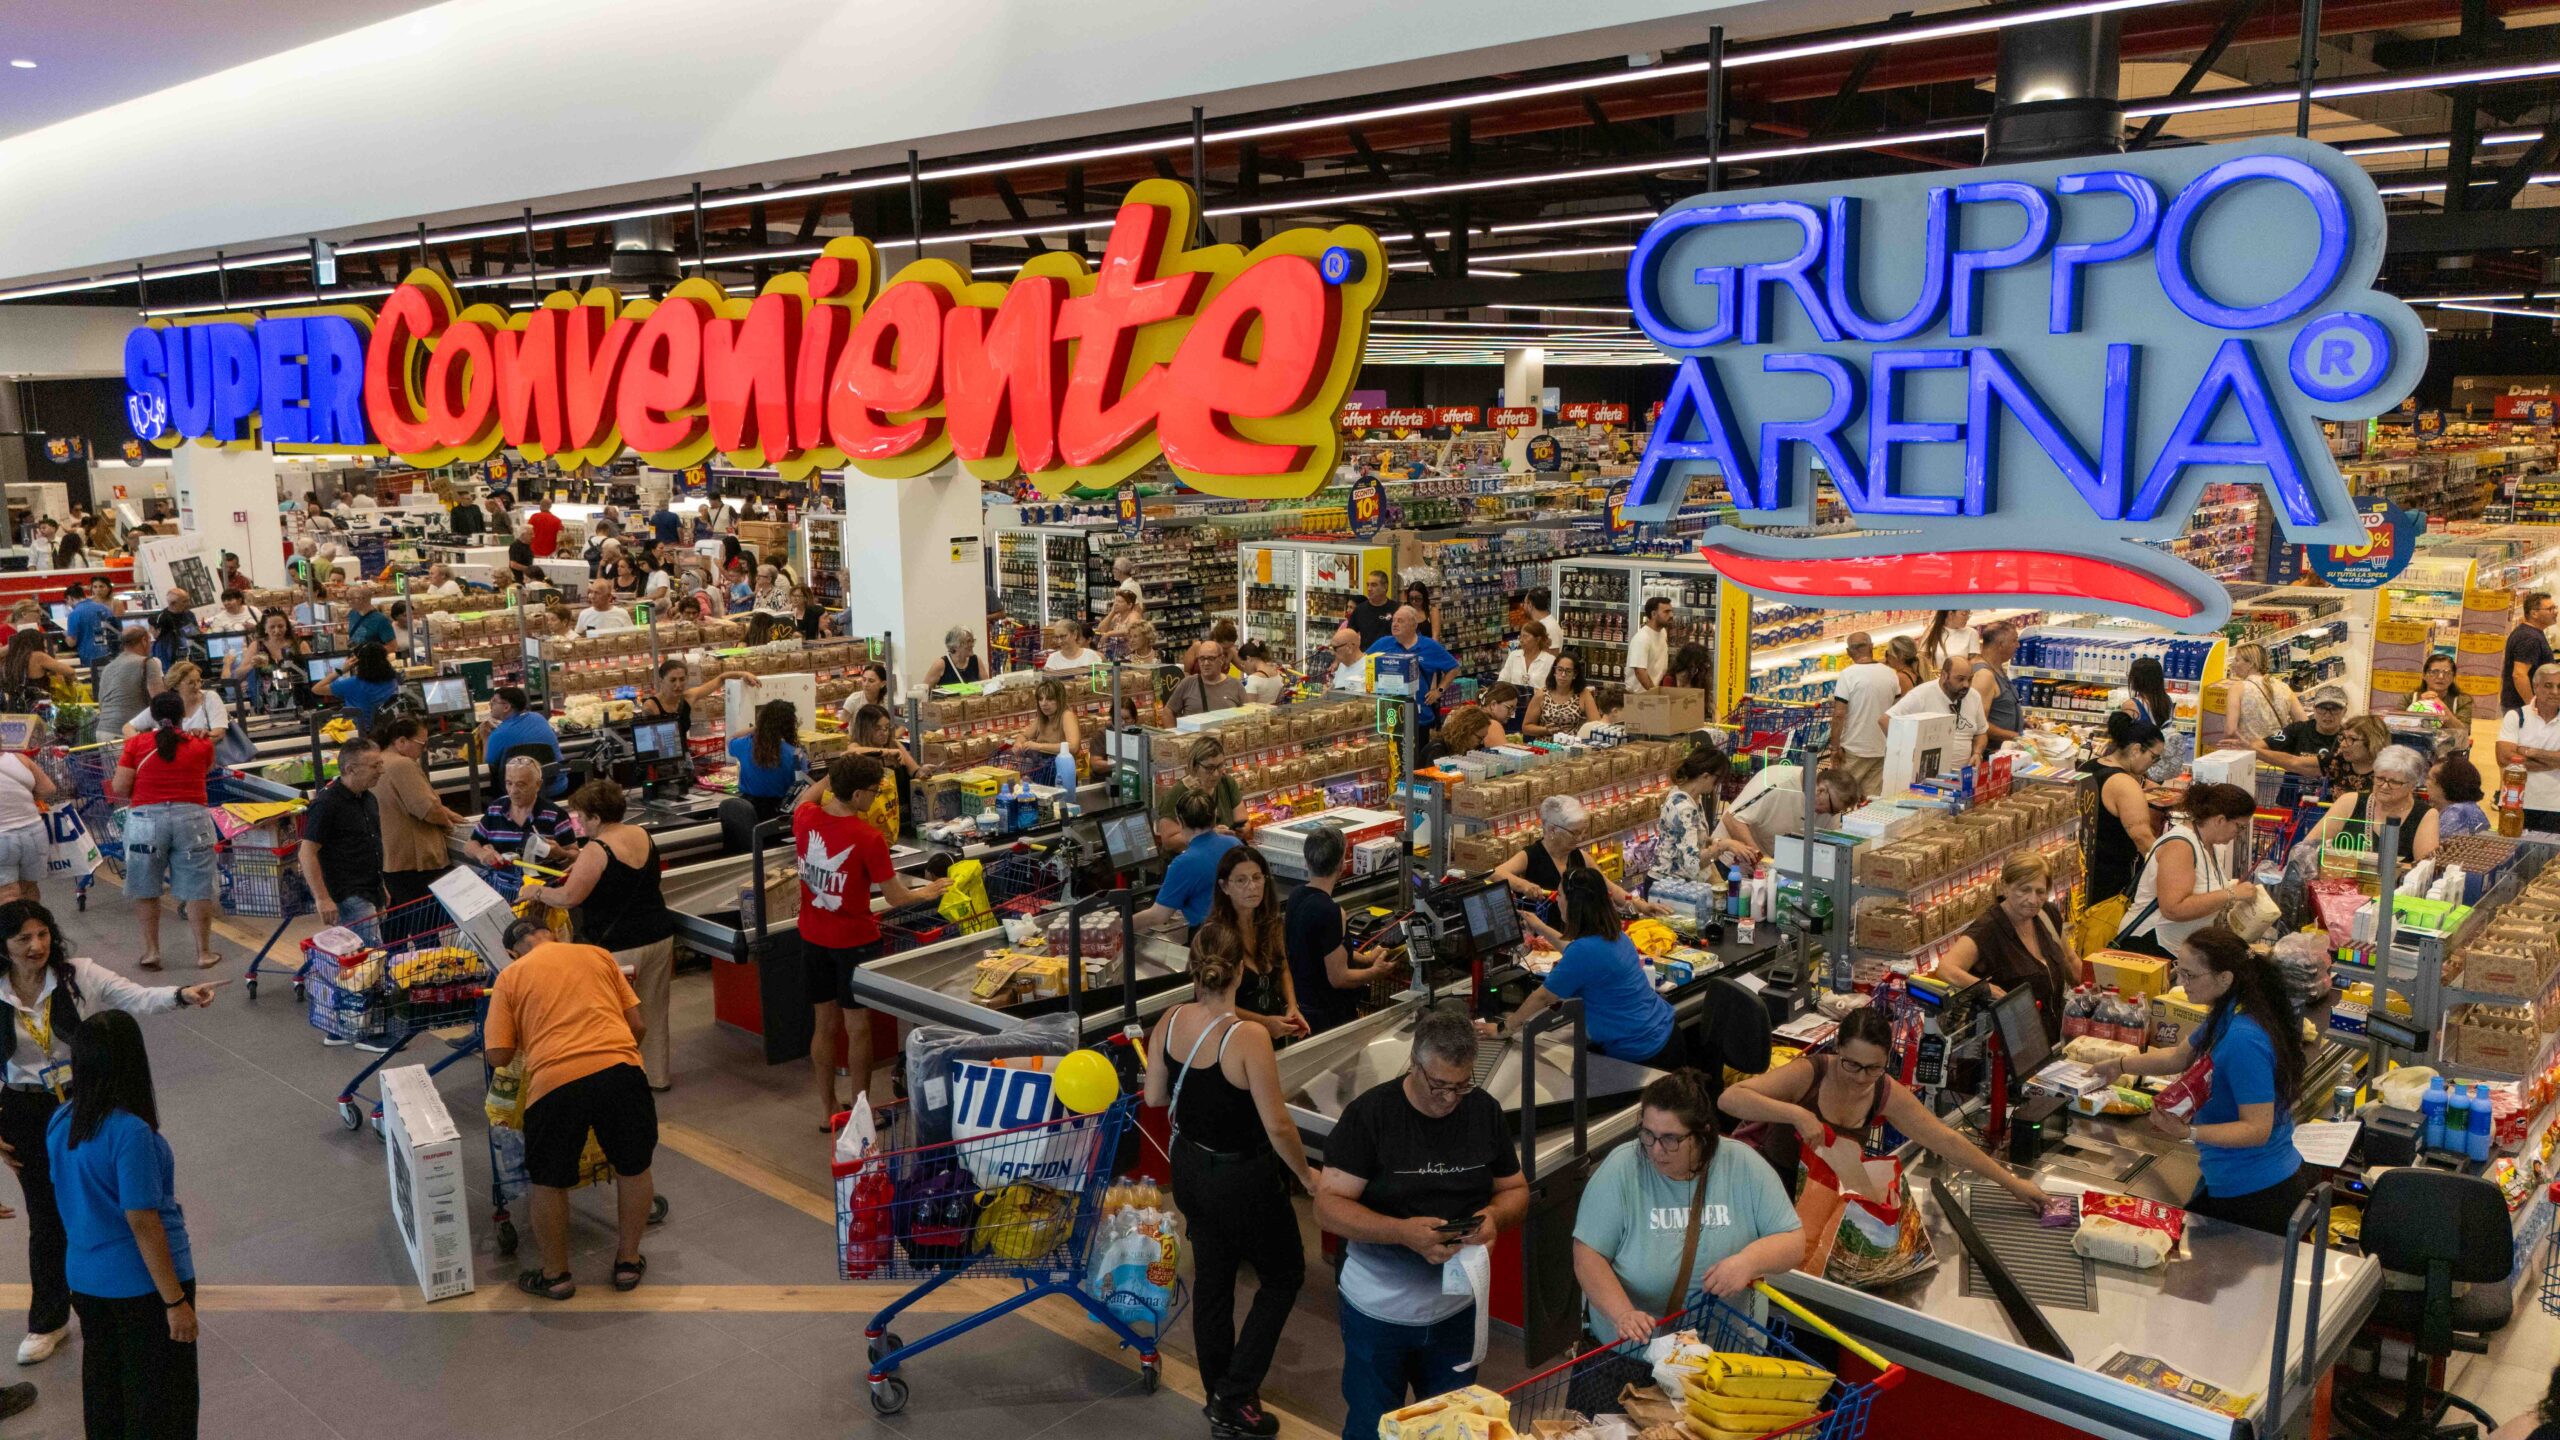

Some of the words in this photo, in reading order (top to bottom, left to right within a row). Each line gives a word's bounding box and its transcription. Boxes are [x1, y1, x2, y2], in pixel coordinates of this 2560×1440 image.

[1627, 154, 2350, 349] GRUPPO
[124, 312, 366, 446] SUPER
[364, 202, 1326, 476] Conveniente
[1381, 410, 1424, 427] offerta
[1443, 409, 1473, 423] offerta
[1496, 410, 1529, 425] offerta
[1594, 406, 1623, 421] offerta
[1624, 338, 2322, 527] ARENA
[1532, 447, 1554, 460] 10%
[490, 465, 507, 480] 10%
[685, 469, 706, 486] 10%
[1354, 488, 1375, 499] SCONTO
[1120, 500, 1136, 518] 10%
[1356, 497, 1379, 519] 10%
[2158, 1026, 2177, 1038] ACE
[998, 1158, 1072, 1181] ACTION
[1162, 1243, 1173, 1260] 2
